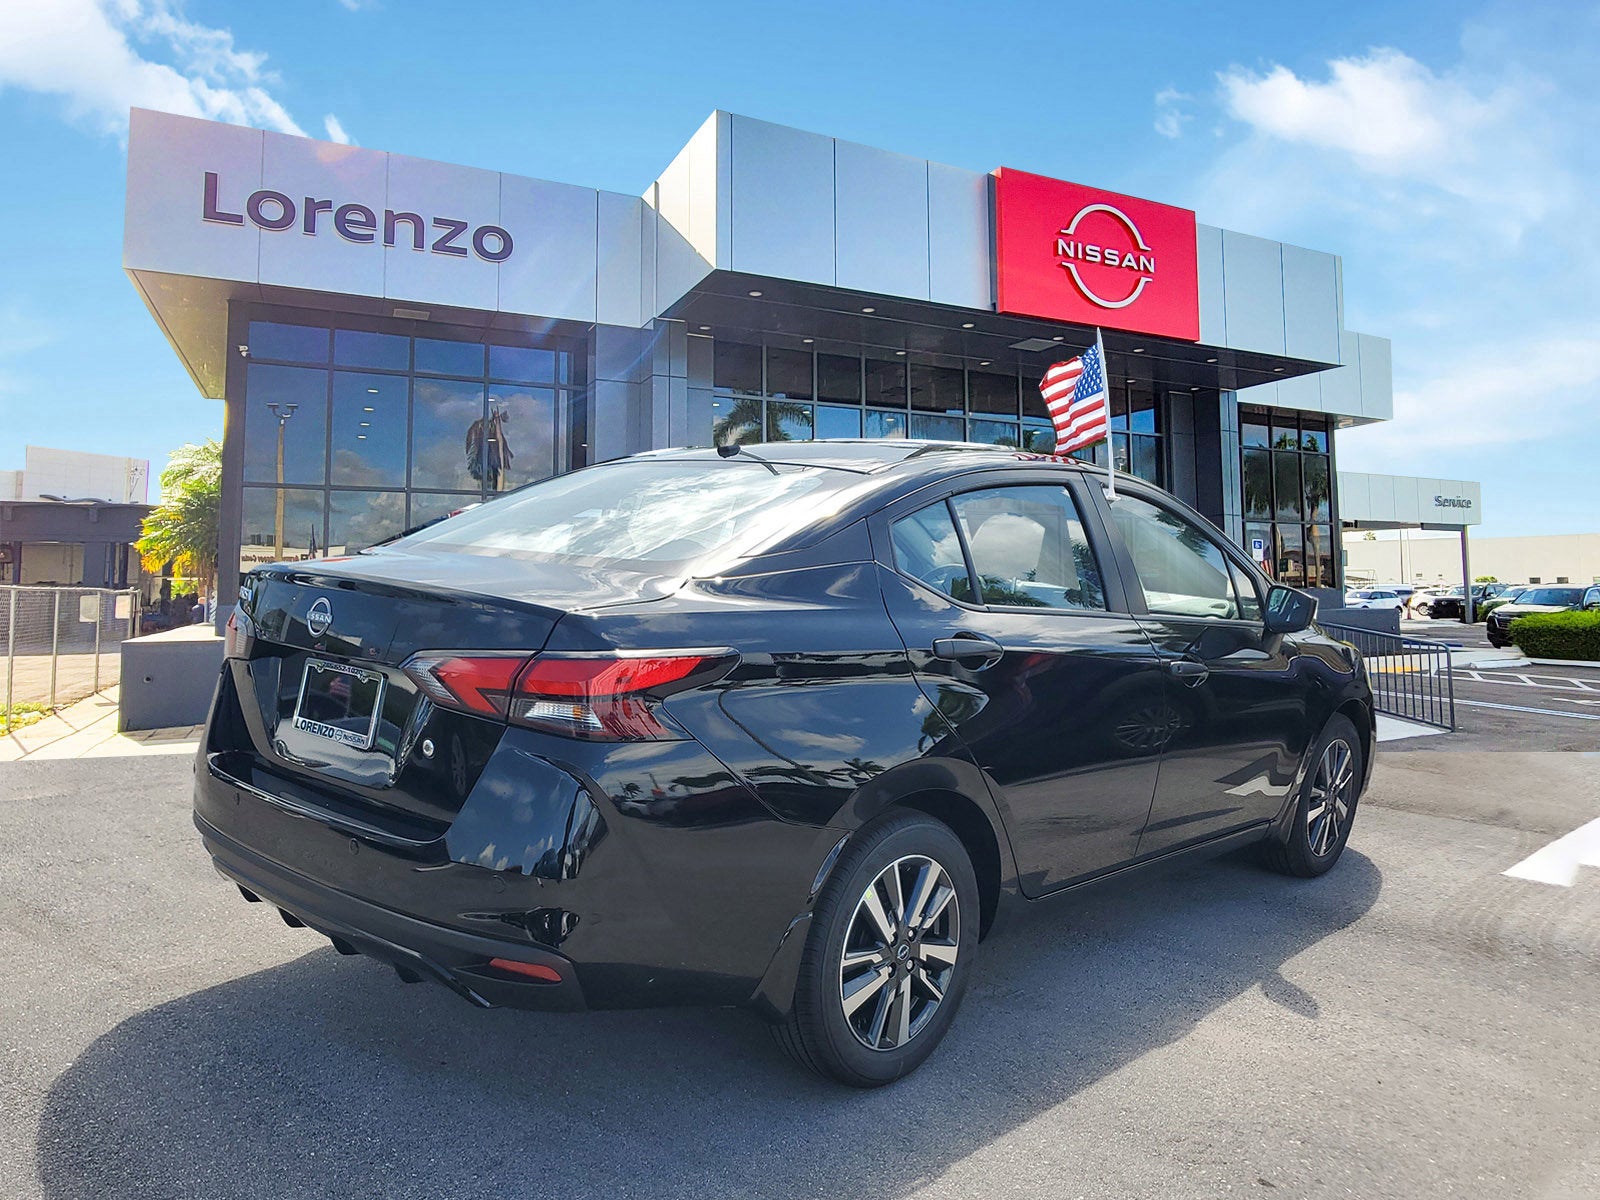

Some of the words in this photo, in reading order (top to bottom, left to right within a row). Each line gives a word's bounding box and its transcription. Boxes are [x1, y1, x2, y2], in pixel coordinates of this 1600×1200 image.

[202, 171, 513, 262] Lorenzo
[1057, 238, 1155, 273] NISSAN
[1434, 495, 1472, 508] Service
[294, 717, 335, 738] LORENZO
[343, 733, 365, 745] NISSAN
